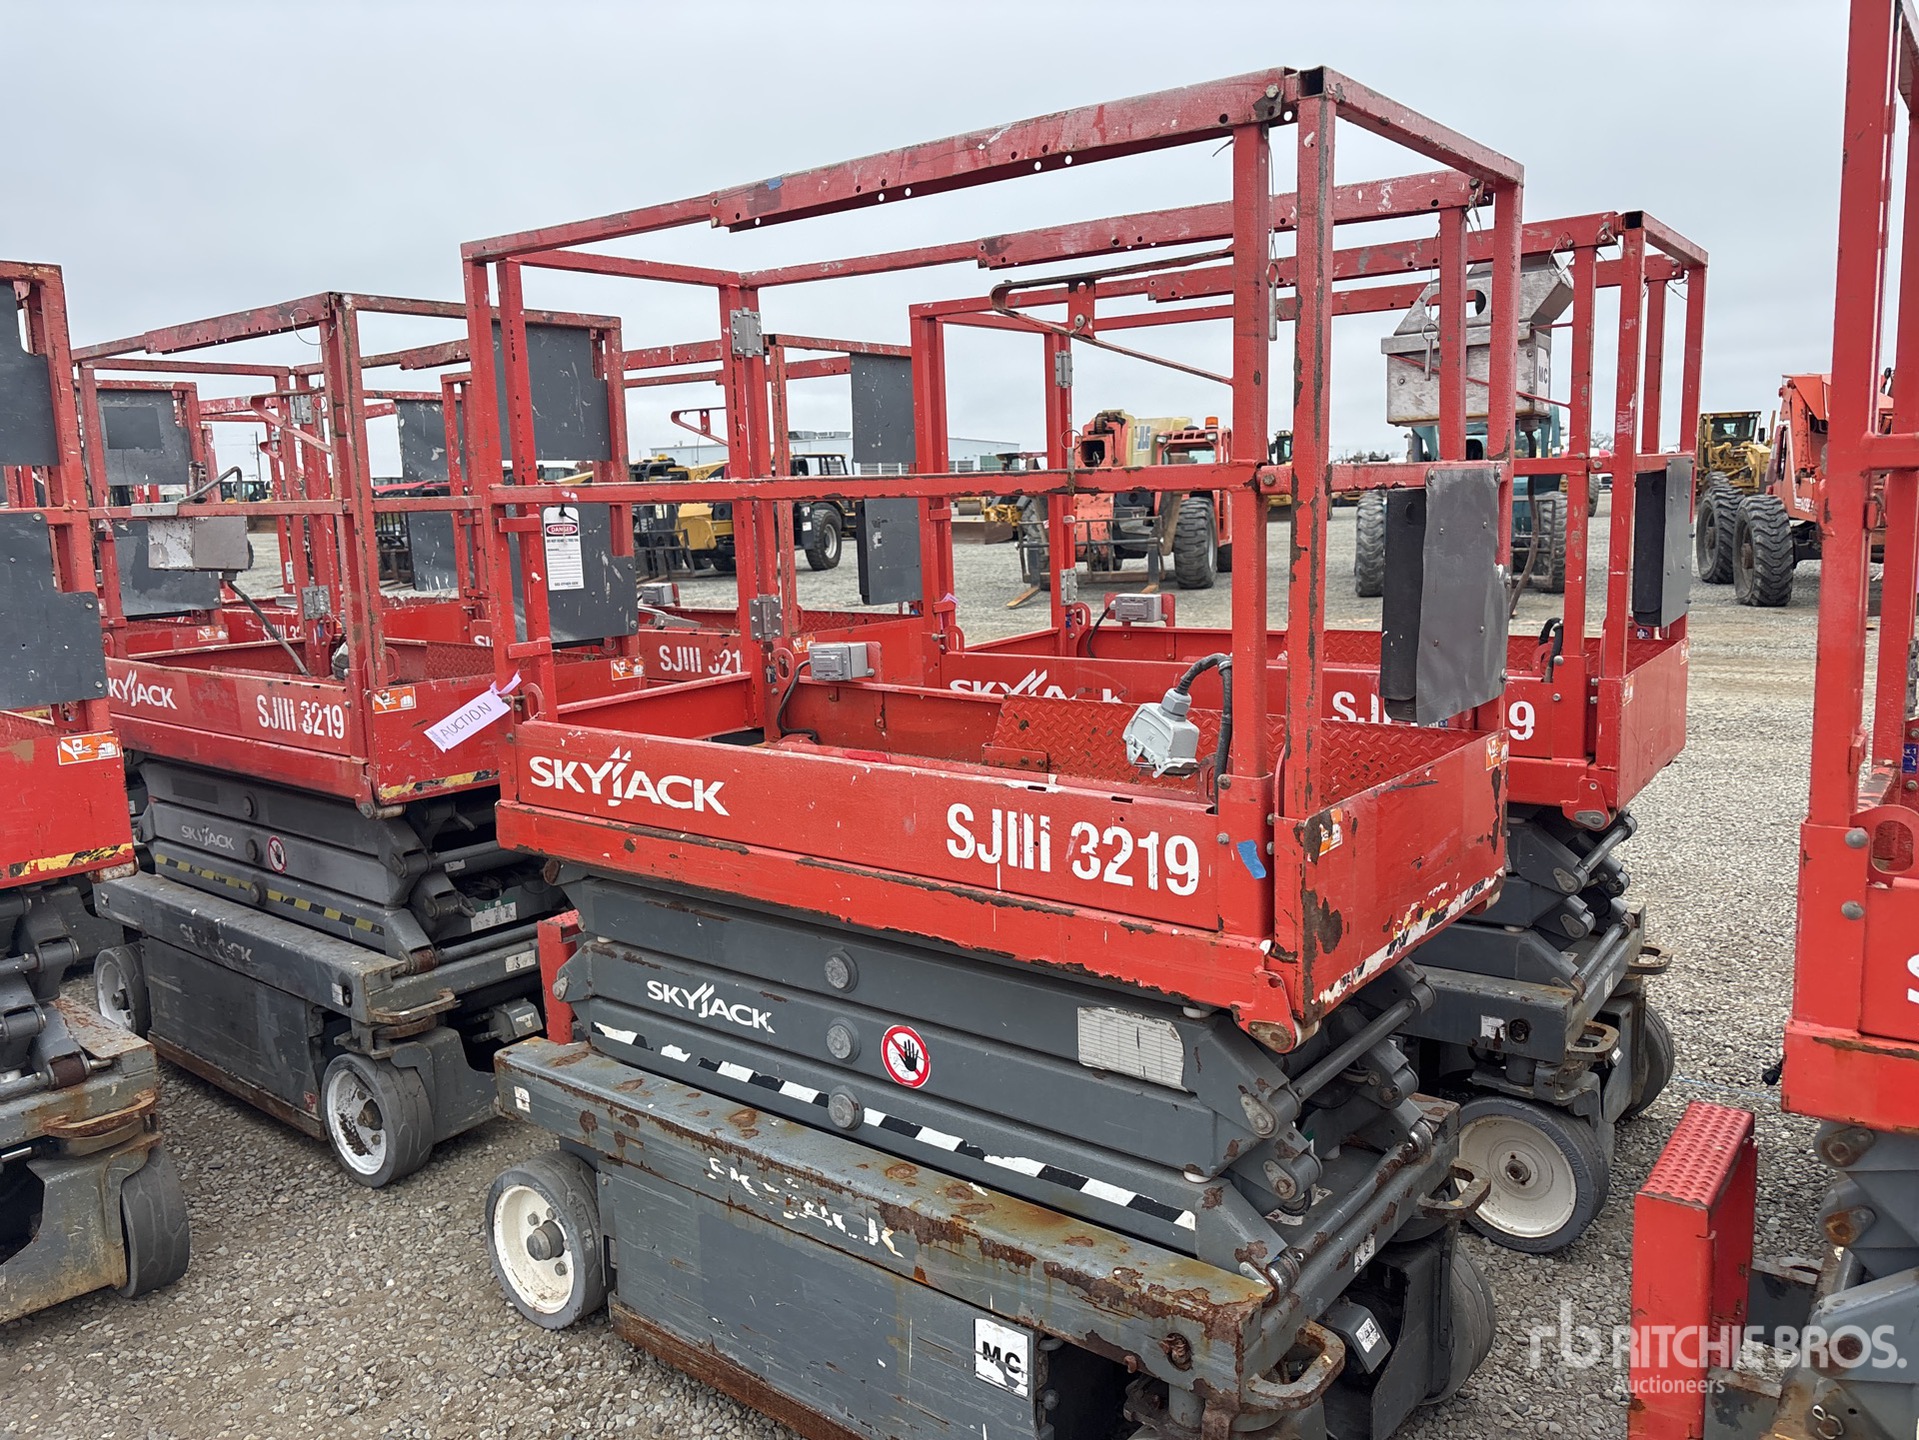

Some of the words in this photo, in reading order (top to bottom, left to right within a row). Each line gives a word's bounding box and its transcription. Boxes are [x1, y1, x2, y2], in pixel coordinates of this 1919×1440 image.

[107, 669, 178, 711] KYJACK
[300, 700, 345, 740] 3219
[440, 701, 492, 741] AUCTION
[529, 745, 731, 817] SKYJACK
[181, 825, 235, 851] SKYJACK
[1071, 821, 1200, 897] 3219
[646, 981, 776, 1034] SKYJACK
